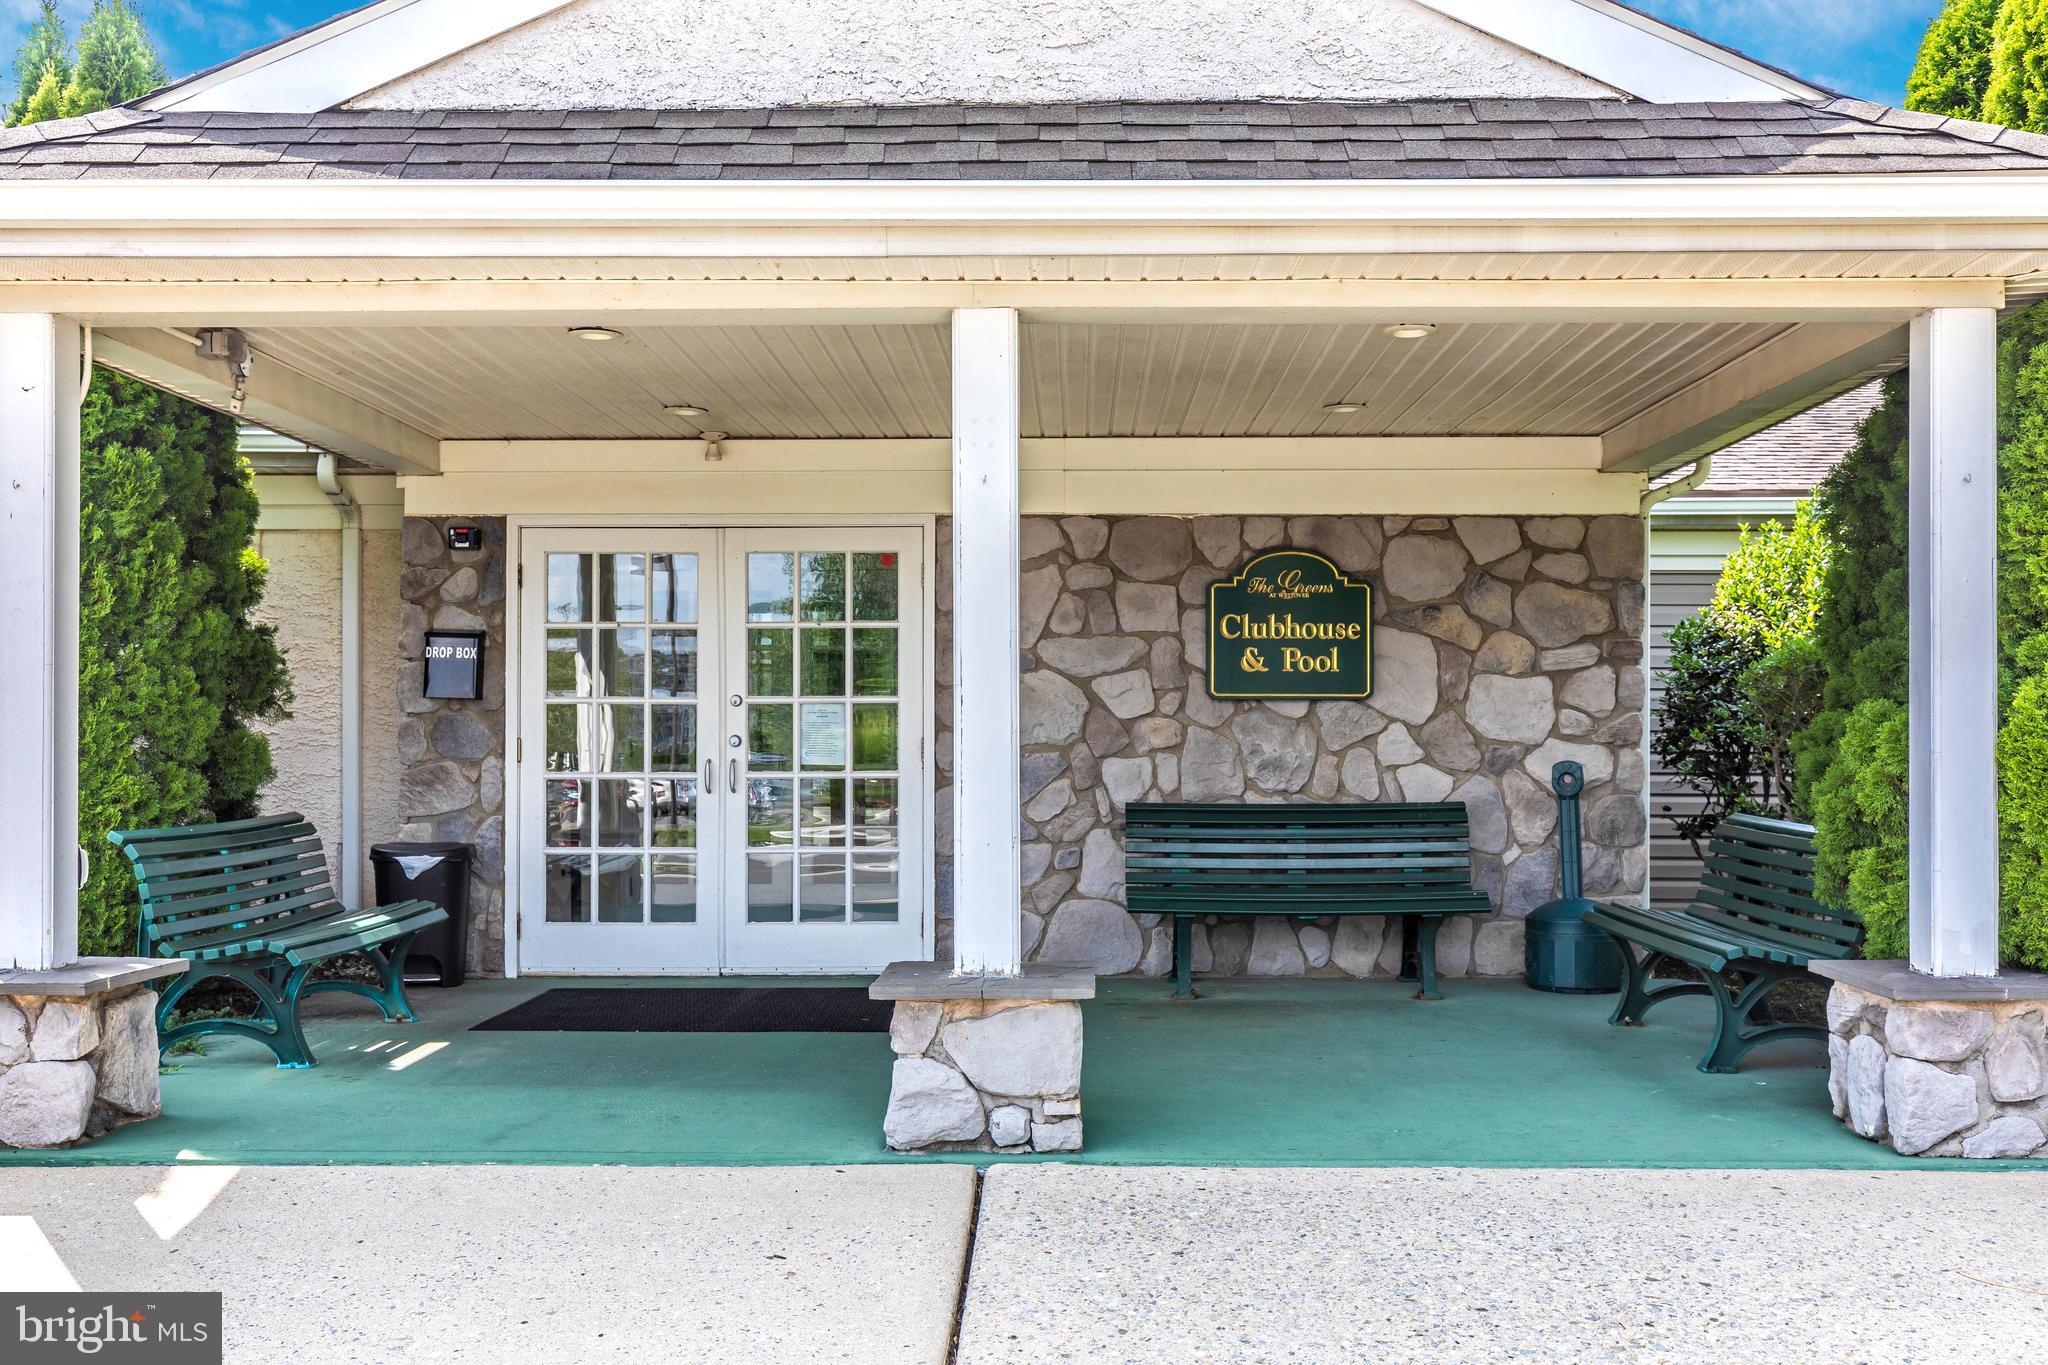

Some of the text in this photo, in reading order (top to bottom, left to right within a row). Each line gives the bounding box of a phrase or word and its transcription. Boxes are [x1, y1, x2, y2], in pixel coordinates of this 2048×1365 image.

[1247, 569, 1334, 594] The Greens
[1219, 613, 1361, 640] Clubhouse
[425, 646, 478, 659] DROP BOX
[1240, 646, 1340, 673] & Pool
